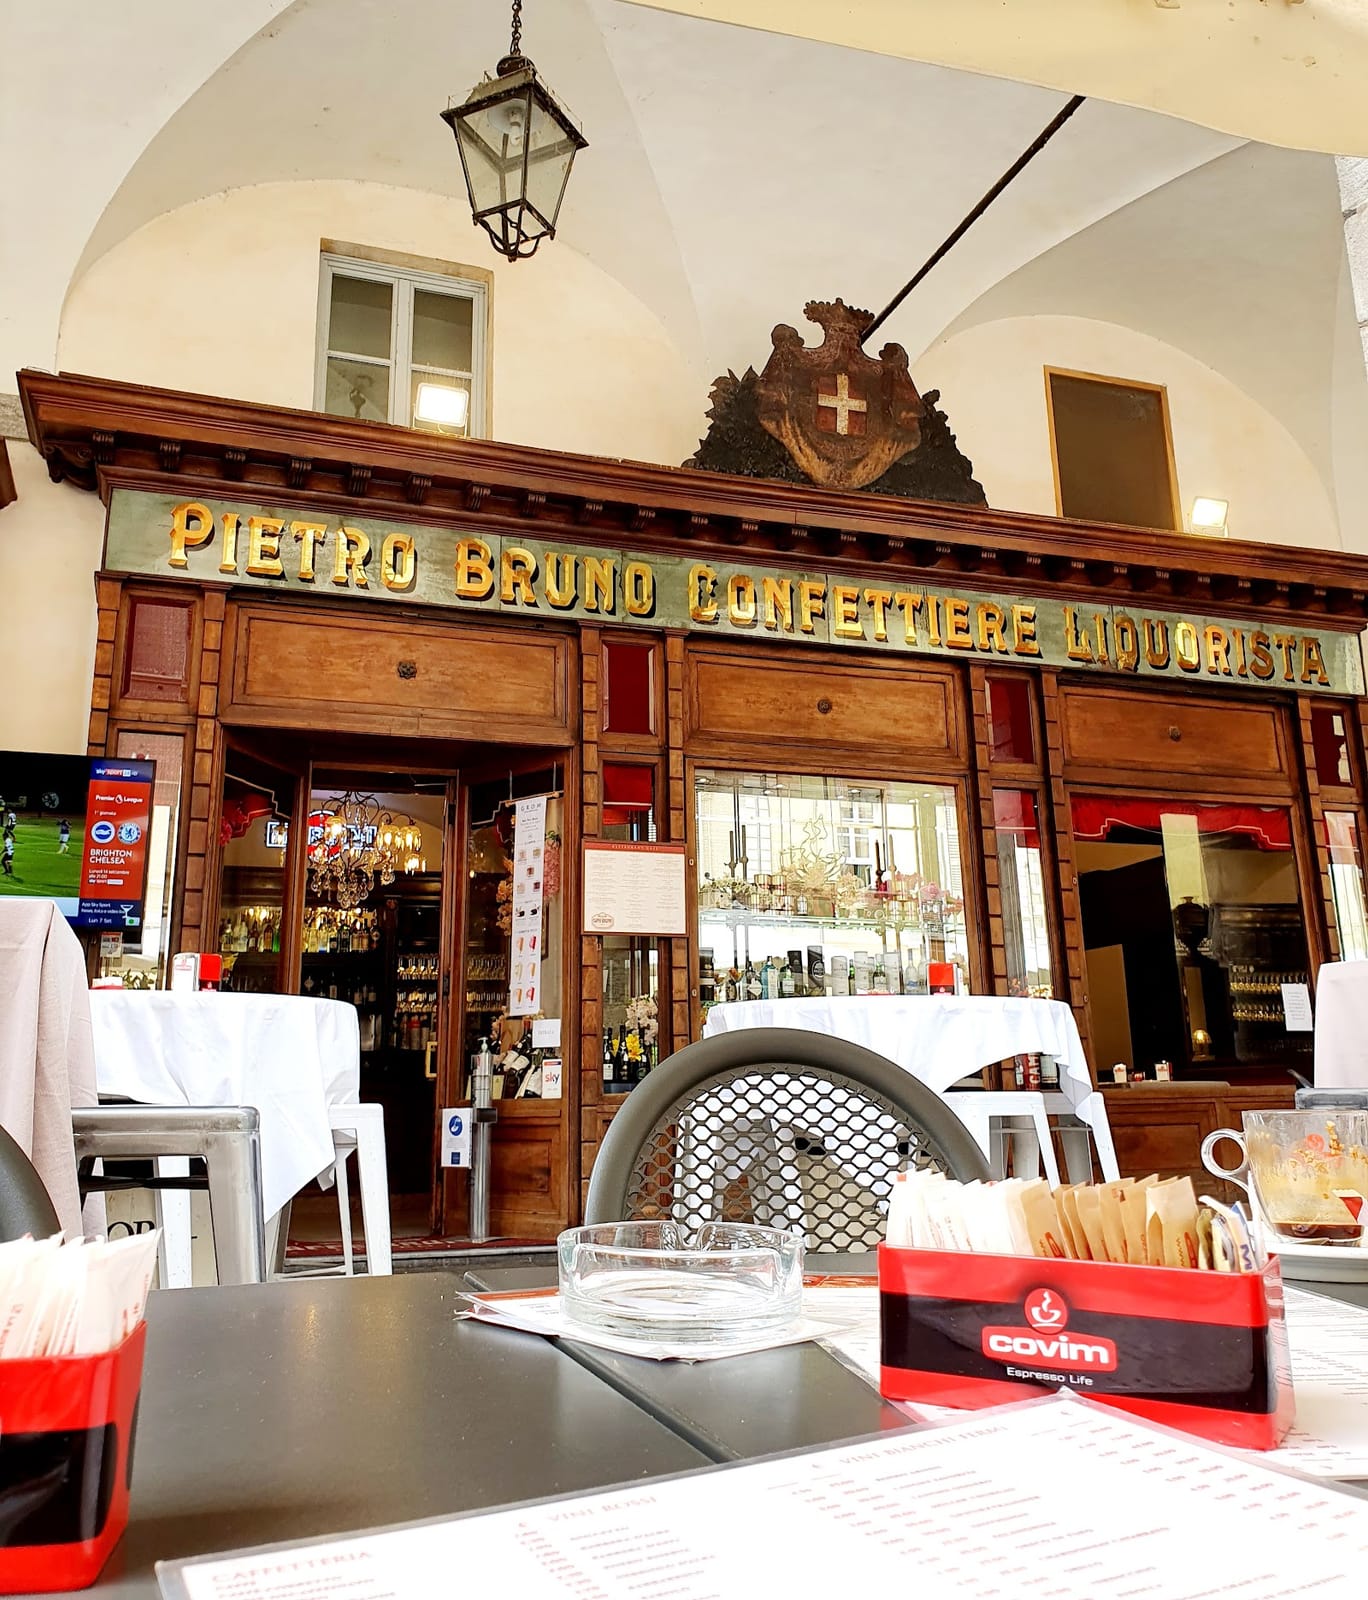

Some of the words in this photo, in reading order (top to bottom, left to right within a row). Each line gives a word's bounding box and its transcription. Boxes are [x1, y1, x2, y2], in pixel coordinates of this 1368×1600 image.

[167, 502, 415, 590] PIETRO
[455, 538, 655, 617] BRUNO
[687, 564, 1040, 656] CONFETTIERE
[1063, 606, 1328, 684] LIQUORISTA
[123, 796, 143, 804] League
[89, 856, 125, 864] CHELSEA
[90, 848, 133, 857] BRIGHTON
[545, 1071, 560, 1085] sky
[988, 1334, 1110, 1364] covim
[1006, 1366, 1066, 1383] Espresso
[1069, 1374, 1094, 1386] Life
[840, 1452, 881, 1465] VINI
[883, 1435, 957, 1457] BIANCHI
